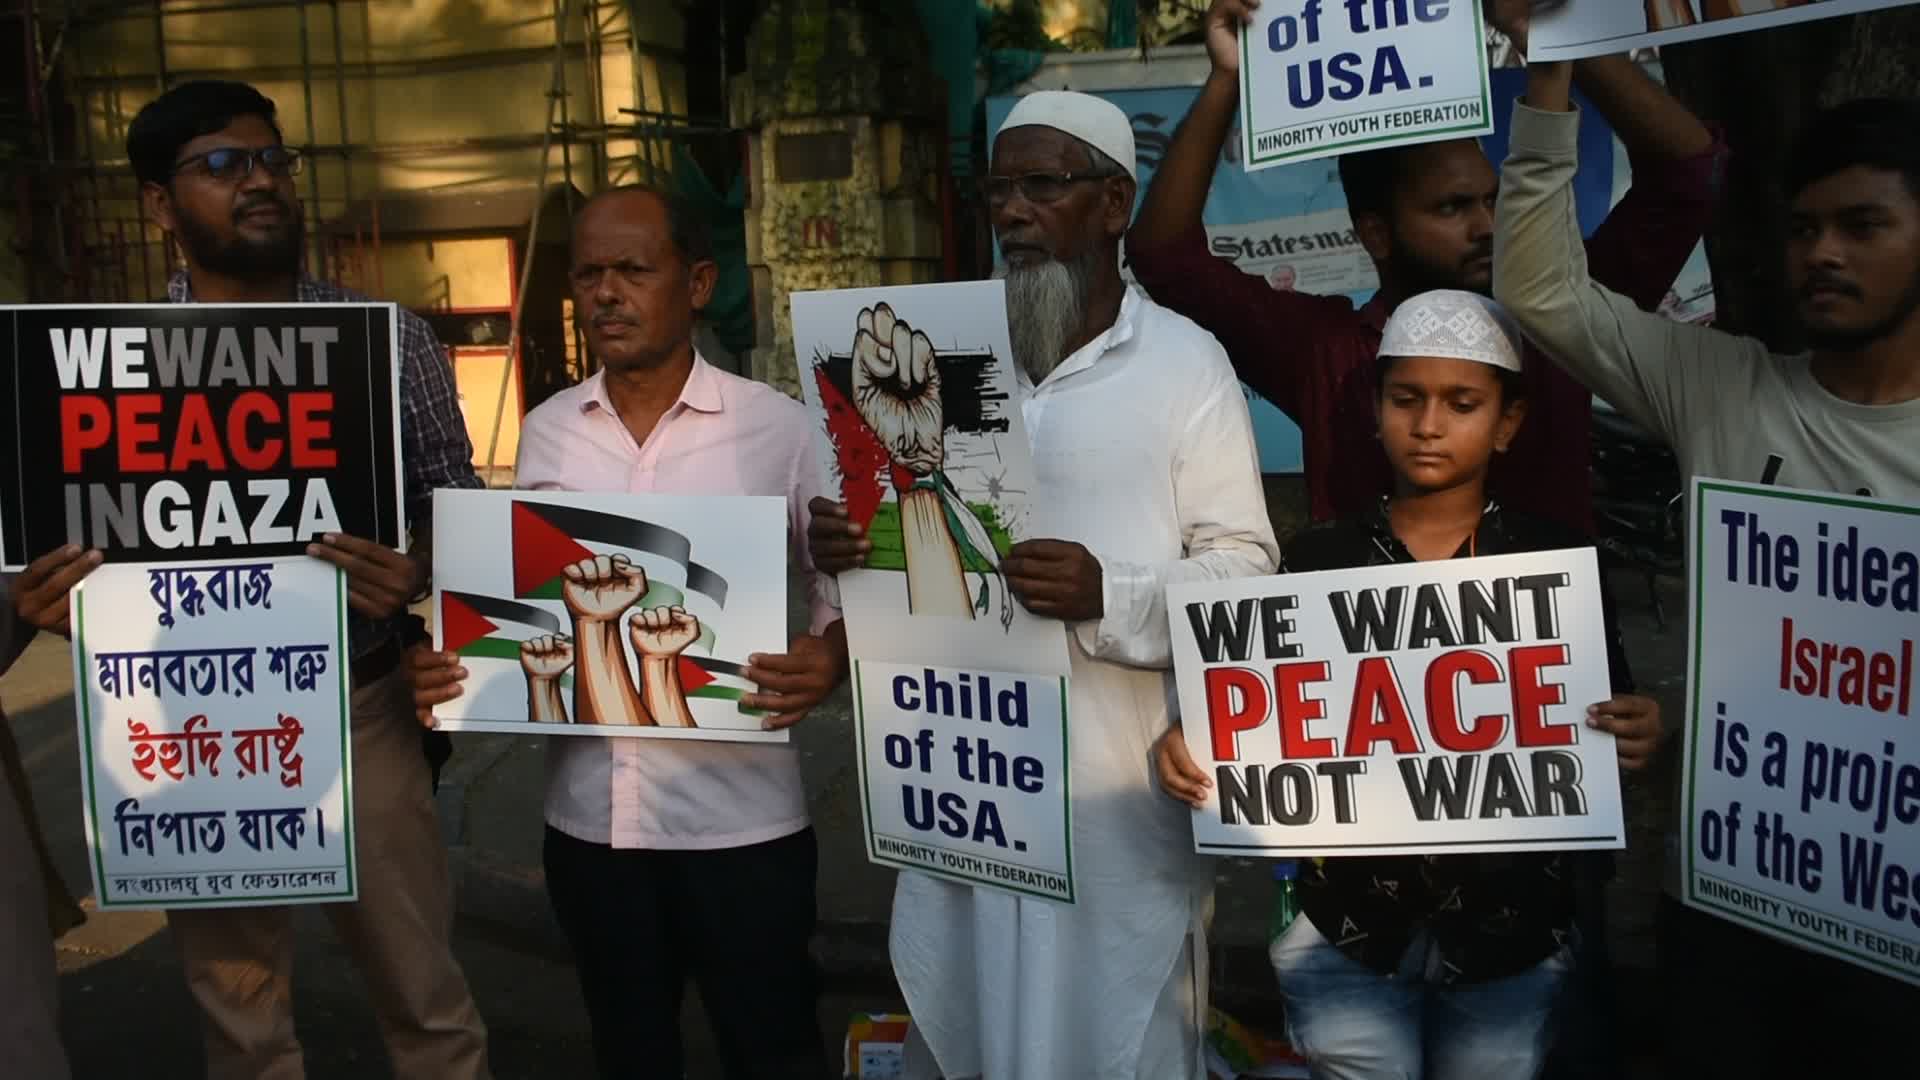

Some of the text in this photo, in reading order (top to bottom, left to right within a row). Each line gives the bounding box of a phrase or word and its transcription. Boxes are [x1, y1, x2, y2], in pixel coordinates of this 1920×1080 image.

[1267, 0, 1449, 52] of the
[1287, 45, 1433, 109] USA.
[1257, 126, 1324, 152] MINORITY
[1329, 116, 1380, 137] YOUTH
[1384, 102, 1481, 130] FEDERATION
[60, 391, 337, 473] PEACE
[1721, 509, 1920, 613] The idea
[147, 563, 274, 630] যুদ্ধবাজ
[1185, 572, 1570, 663] WE WANT
[95, 644, 329, 700] মানবতার শত্রু
[892, 668, 1029, 728] child
[1780, 616, 1913, 716] Israel
[1204, 643, 1578, 761] PEACE
[127, 713, 304, 788] ইহুদি রাষ্ট্র
[884, 729, 1044, 793] of the
[1713, 701, 1750, 778] is
[1761, 731, 1788, 788] a
[902, 784, 1028, 852] USA.
[1215, 750, 1588, 826] NOT WAR
[114, 798, 226, 856] নিপাত
[1700, 801, 1741, 867] of
[1754, 810, 1823, 893] the
[207, 874, 234, 895] যুব
[878, 838, 1067, 893] MINORITY YOUTH FEDERATION
[1699, 877, 1783, 920] MINORITY
[1787, 906, 1848, 942] YOUTH
